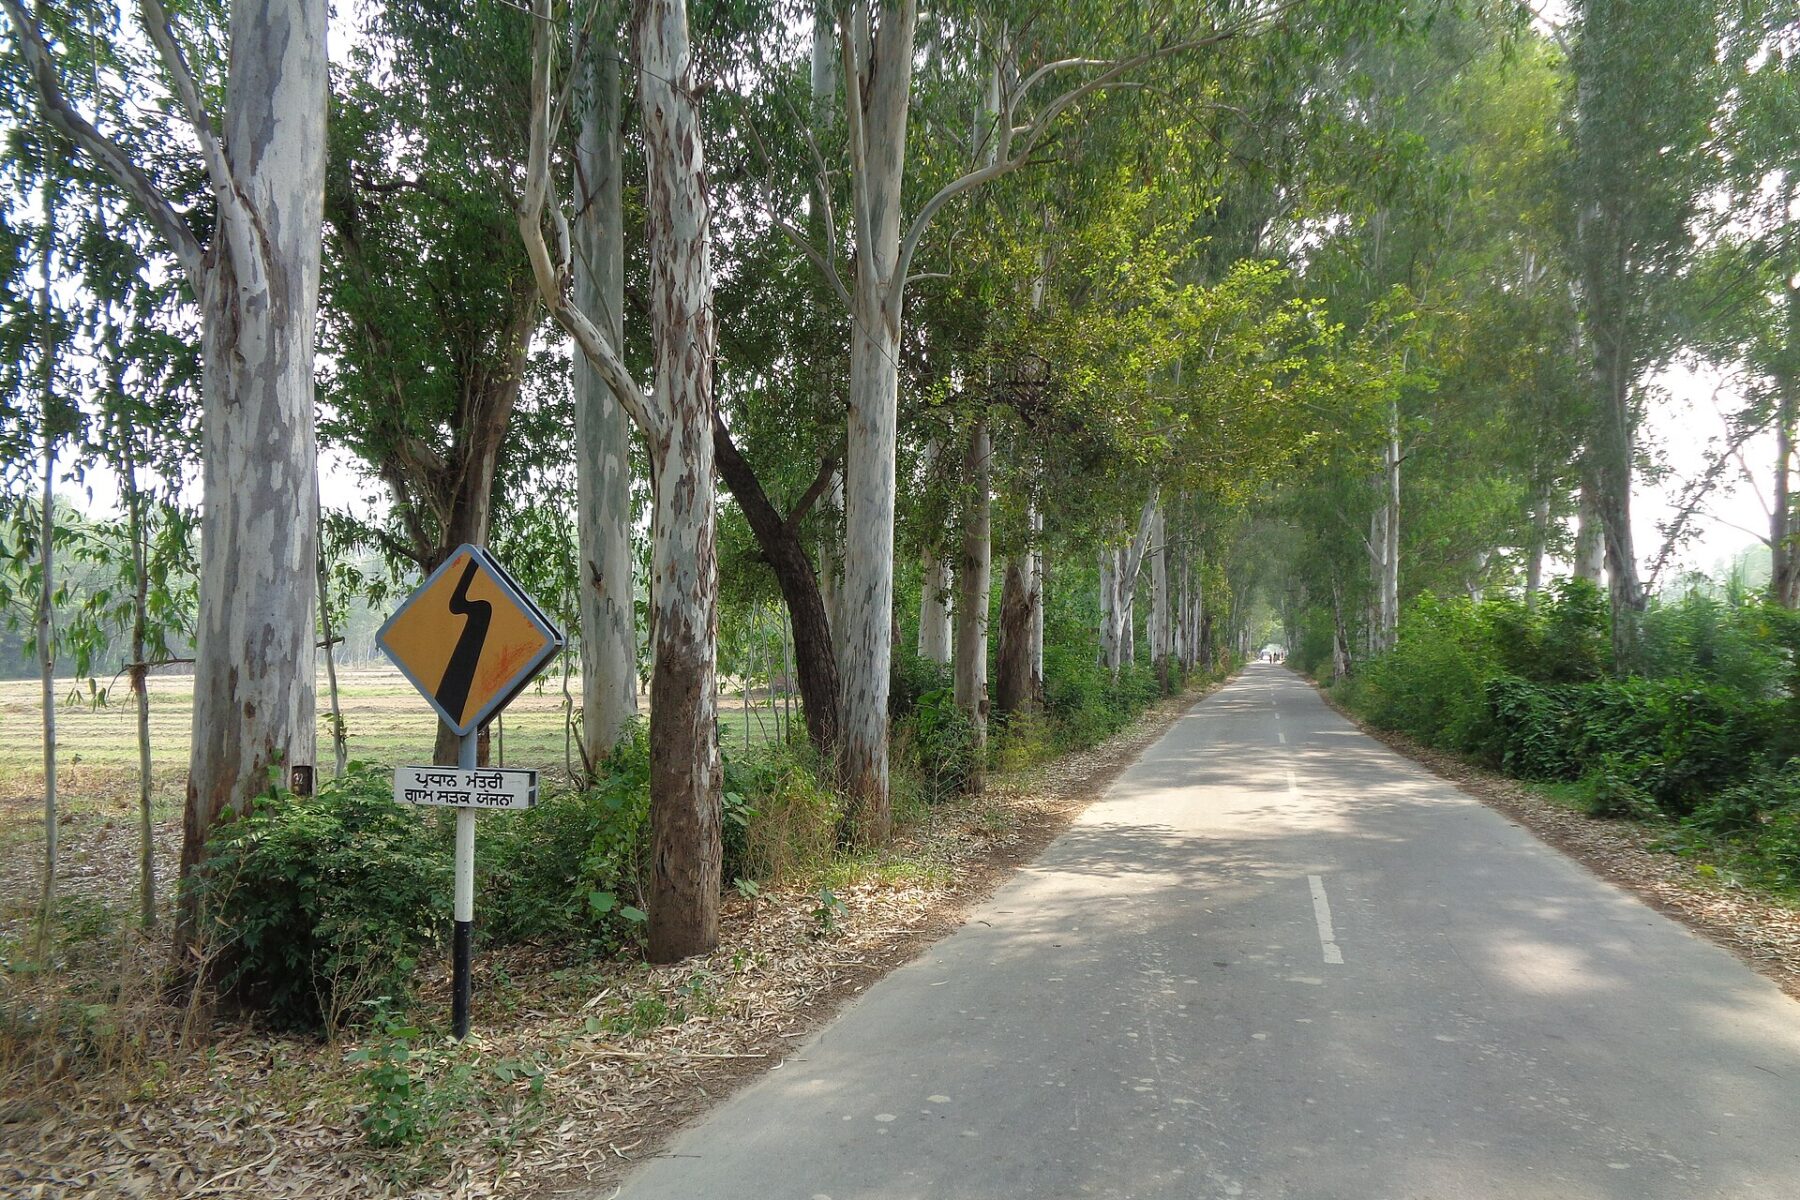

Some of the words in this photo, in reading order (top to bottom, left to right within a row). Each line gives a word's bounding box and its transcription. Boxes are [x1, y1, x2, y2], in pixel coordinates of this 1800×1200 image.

[415, 773, 457, 788] ਪ੍ਰਧਾਨ
[404, 788, 434, 804] ਗ੍ਰਾਮ
[437, 790, 471, 804] ਸੜਕ
